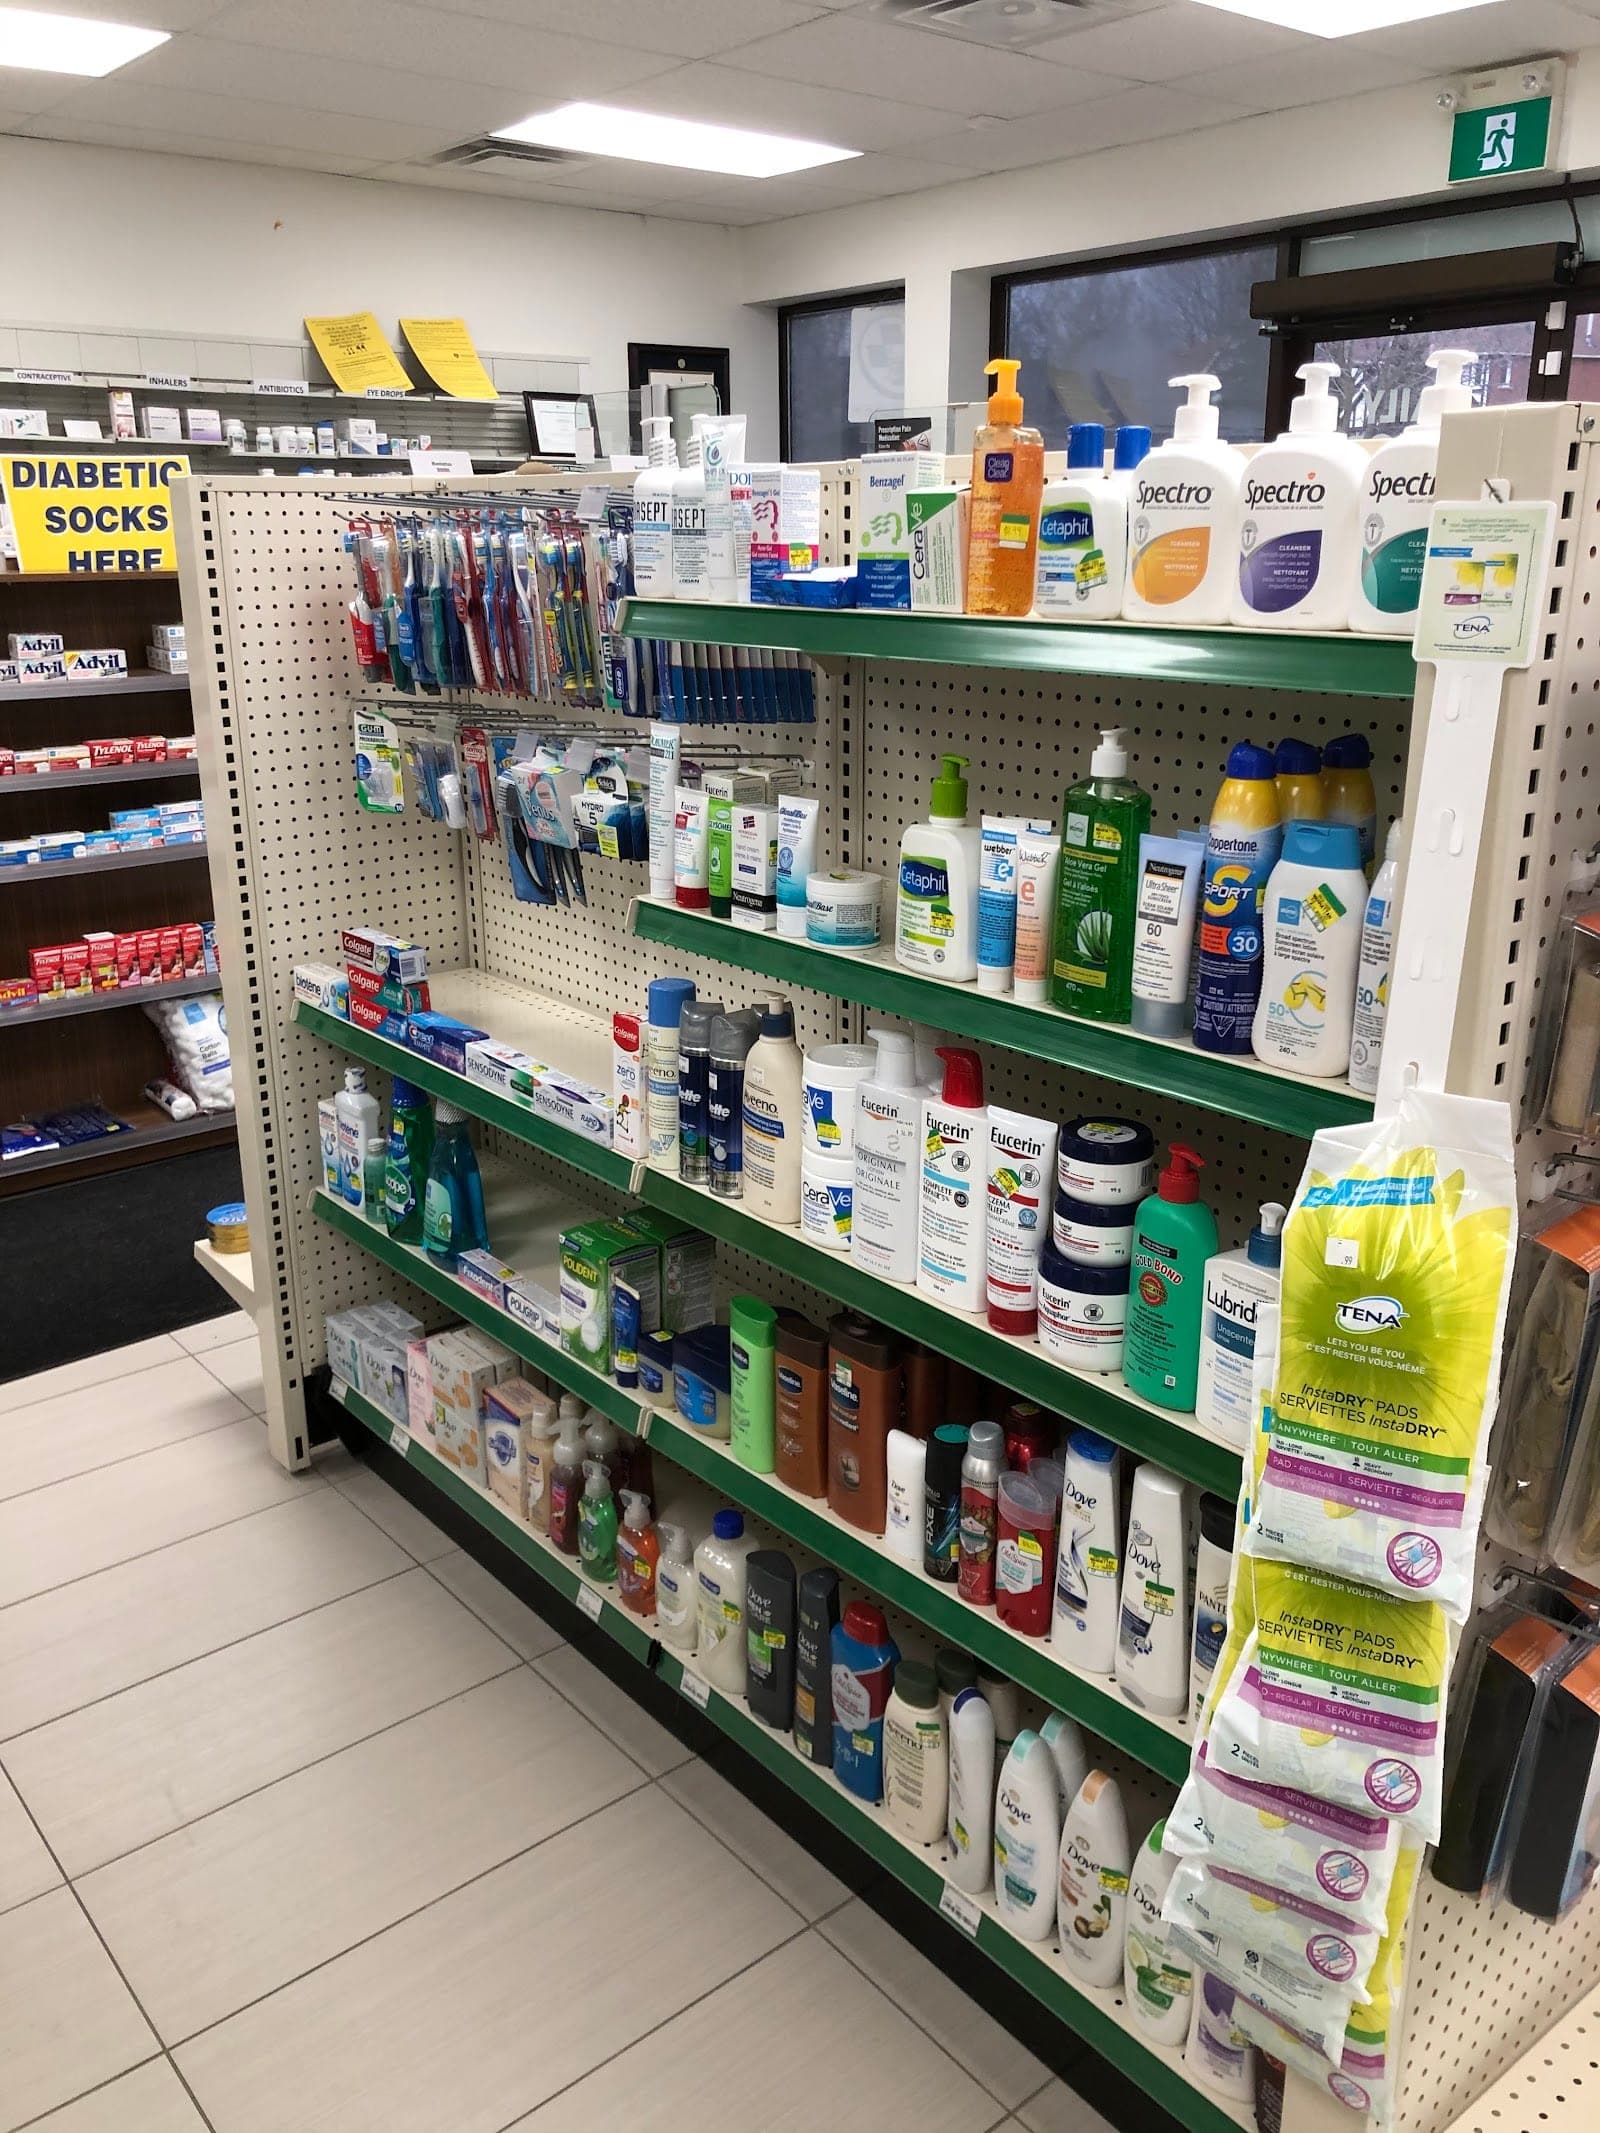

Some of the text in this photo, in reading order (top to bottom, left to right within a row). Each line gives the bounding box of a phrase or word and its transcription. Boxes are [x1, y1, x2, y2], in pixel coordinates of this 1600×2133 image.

[17, 372, 71, 382] CONTRACEPTIVE
[149, 377, 188, 388] INHALERS
[258, 384, 304, 394] ANTIBIOTICS
[381, 390, 404, 398] DROPS
[12, 461, 183, 488] DIABETIC
[870, 473, 904, 490] Benzagel
[1136, 481, 1212, 510] Spectro
[1245, 479, 1325, 511] Spectro
[45, 504, 169, 534] SOCKS
[1041, 516, 1090, 541] Cetaphil
[68, 548, 162, 572] HERE
[1453, 623, 1491, 633] TENA
[21, 638, 61, 652] Advil
[24, 660, 65, 676] Advil
[74, 654, 121, 672] Advil
[93, 743, 134, 757] TYLENOL
[136, 740, 166, 752] TYLENOL
[704, 784, 729, 798] Eucerin
[582, 801, 604, 813] HYDRO
[588, 812, 598, 826] 5
[984, 843, 1012, 856] webber
[1078, 860, 1093, 870] Vera
[1094, 862, 1107, 873] Gel
[900, 863, 947, 893] Cetaphil
[733, 890, 763, 907] Neutrogena
[1204, 881, 1253, 900] SPORT
[1146, 922, 1162, 937] 60
[343, 937, 373, 955] Colgate
[1232, 936, 1258, 953] 30
[1274, 946, 1290, 954] Lotion
[1275, 938, 1300, 948] Sunscreen
[348, 970, 380, 992] Colgate
[351, 1000, 382, 1024] Colgate
[614, 1025, 638, 1042] Colgate
[467, 1056, 507, 1084] SENSODYNE
[617, 1064, 636, 1081] zero
[535, 1092, 575, 1121] SENSODYNE
[861, 1095, 898, 1118] Eucerin
[581, 1114, 598, 1127] RAPID
[926, 1111, 970, 1140] Eucerin
[990, 1126, 1042, 1157] Eucerin
[858, 1151, 898, 1173] ORIGINAL
[855, 1167, 901, 1191] ORIGINALE
[923, 1178, 953, 1196] COMPLETE
[803, 1181, 851, 1207] CeraVe
[563, 1255, 599, 1283] POLIDENT
[1135, 1253, 1183, 1285] GOLD BOND
[510, 1296, 540, 1323] POLIGRIP
[1042, 1287, 1071, 1310] Eucerin
[1207, 1280, 1257, 1325] Lubrid
[1337, 1303, 1402, 1329] TENA
[1217, 1321, 1255, 1346] Unscente
[1306, 1342, 1426, 1376] C'EST RESTER VOUS-MÊME
[1327, 1336, 1406, 1360] LETS YOU BE YOU
[366, 1353, 386, 1372] Dove
[430, 1355, 450, 1374] Dove
[409, 1367, 425, 1383] Dove
[1279, 1391, 1366, 1424] SERVIETTES
[1375, 1401, 1419, 1420] PADS
[1277, 1424, 1419, 1465] ANYWHERE TOUT ALLER
[1273, 1456, 1292, 1469] PAD
[1347, 1476, 1403, 1497] SERVIETTE
[1066, 1479, 1097, 1509] Dove
[926, 1504, 935, 1546] AXE
[1256, 1522, 1264, 1536] 2
[1127, 1539, 1162, 1575] Dove
[1199, 1591, 1228, 1615] PANTE
[1258, 1618, 1344, 1652] SERVIETTES
[1354, 1630, 1395, 1650] PADS
[1260, 1651, 1398, 1693] NYWHERE TOUT ALLER
[1325, 1703, 1380, 1725] SERVIETTE
[1231, 1744, 1240, 1757] 2
[1000, 1791, 1032, 1824] Dove
[1193, 1817, 1203, 1831] 2
[1067, 1845, 1101, 1874] Dove
[1132, 1882, 1163, 1919] Dov
[1186, 1893, 1195, 1905] 2
